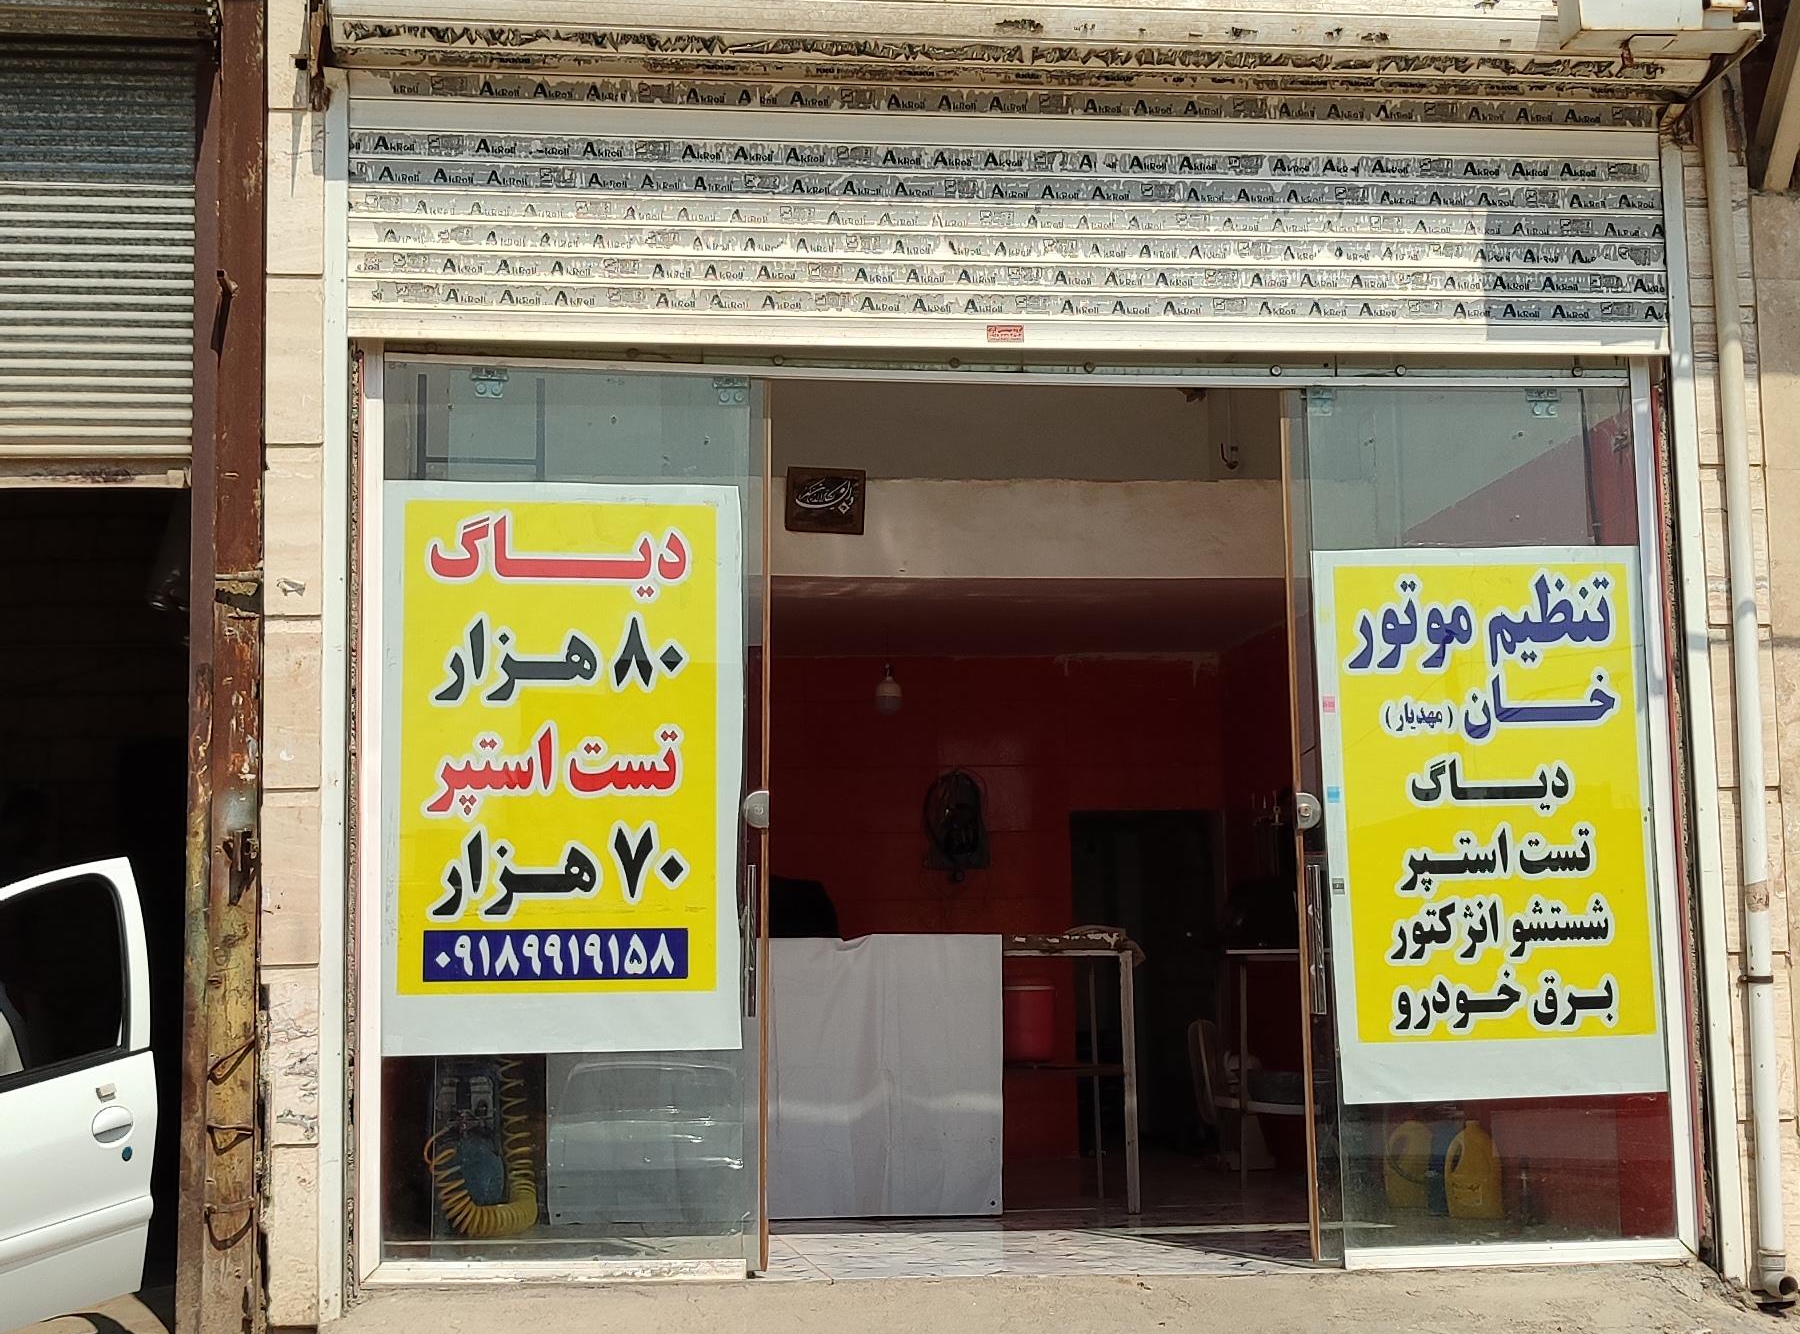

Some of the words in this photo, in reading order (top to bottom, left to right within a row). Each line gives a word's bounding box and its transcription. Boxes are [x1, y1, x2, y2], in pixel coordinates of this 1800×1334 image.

[430, 516, 688, 598] دیاگ
[614, 617, 685, 687] ۸۰
[1347, 580, 1472, 669] موتور
[1488, 572, 1612, 667] تنظیم
[434, 618, 598, 701] هزار
[1464, 672, 1616, 739] خان
[426, 726, 552, 815] استپر
[569, 729, 679, 793] تست
[1411, 760, 1570, 811] دیاگ
[432, 829, 598, 916] هزار
[614, 825, 685, 898] ۷۰
[1400, 828, 1508, 891] استپر
[1519, 827, 1590, 874] تست
[435, 933, 675, 975] ۰۹۱۸۹۹۱۹۱۵۸
[1390, 901, 1498, 961] انژکتور
[1509, 899, 1610, 957] شستشو
[1395, 970, 1521, 1031] خودرو
[1534, 976, 1613, 1028] برق
